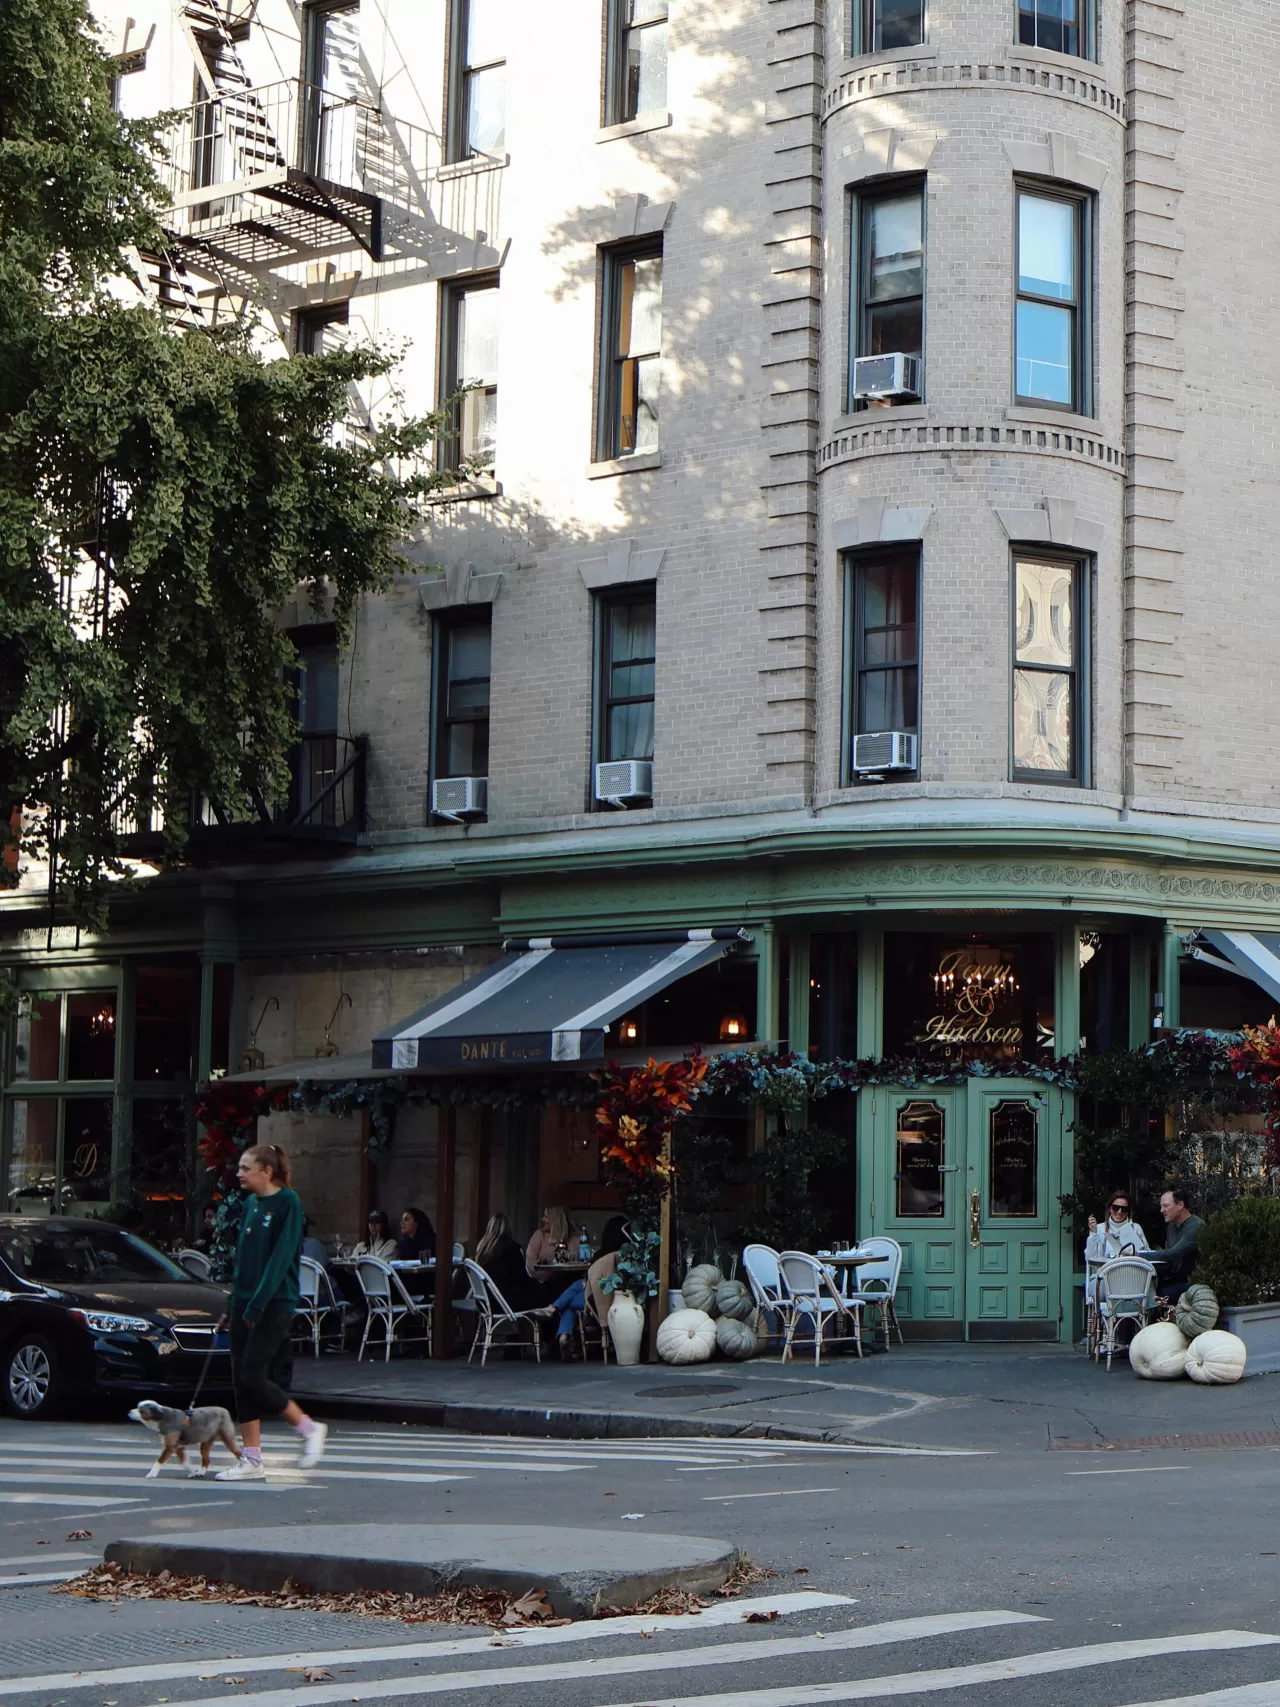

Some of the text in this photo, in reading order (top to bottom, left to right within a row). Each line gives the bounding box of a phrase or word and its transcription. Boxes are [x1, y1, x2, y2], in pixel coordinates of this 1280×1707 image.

[929, 951, 1011, 990] Perry
[957, 985, 995, 1017] &
[916, 1014, 1024, 1043] Hudson
[461, 1040, 507, 1060] DANTE
